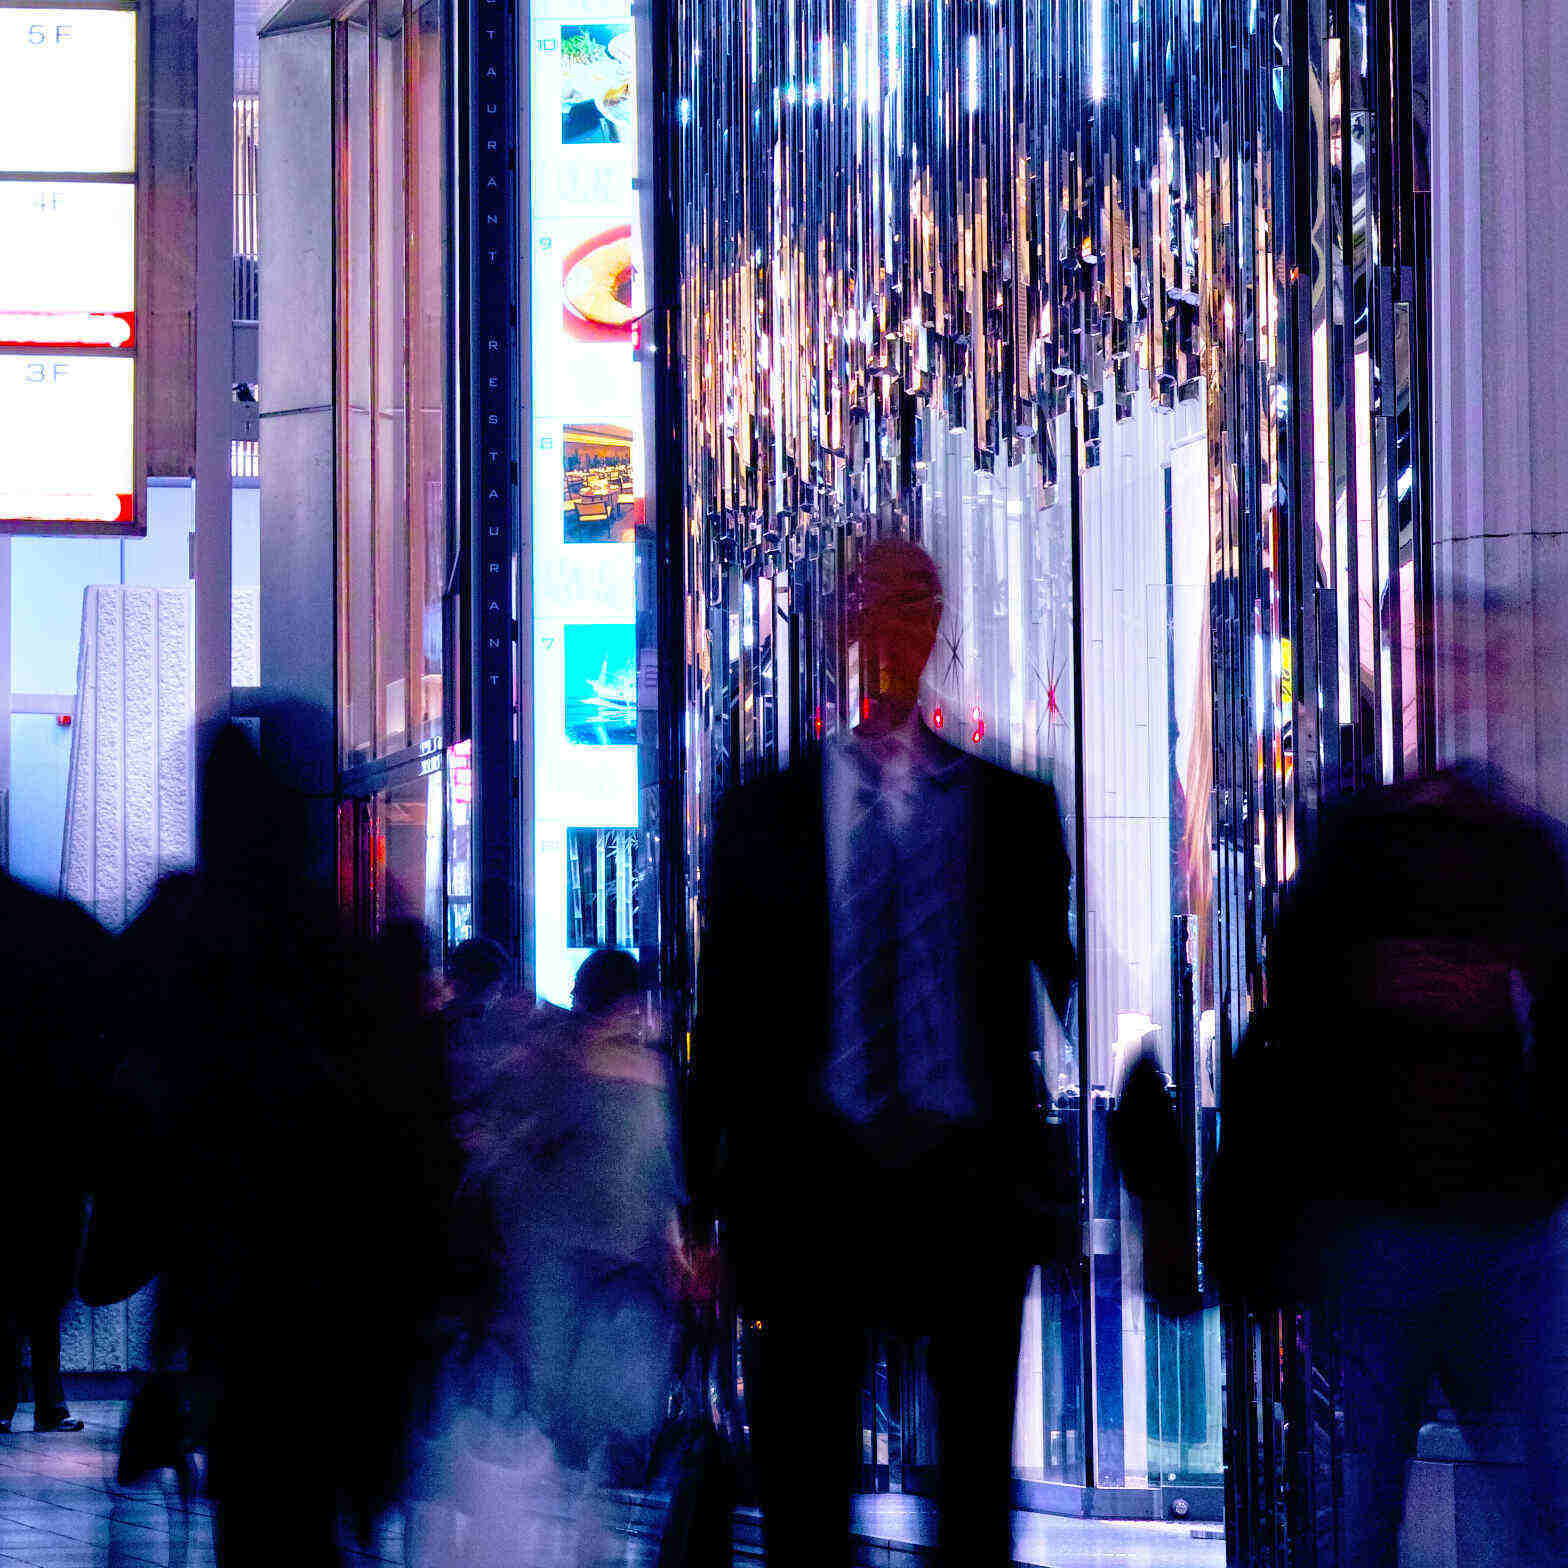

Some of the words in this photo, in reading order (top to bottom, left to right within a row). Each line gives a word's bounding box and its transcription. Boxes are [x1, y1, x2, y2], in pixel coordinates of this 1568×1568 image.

[27, 24, 74, 46] 5F
[25, 362, 72, 383] 3F
[488, 339, 500, 685] RESTAURANT
